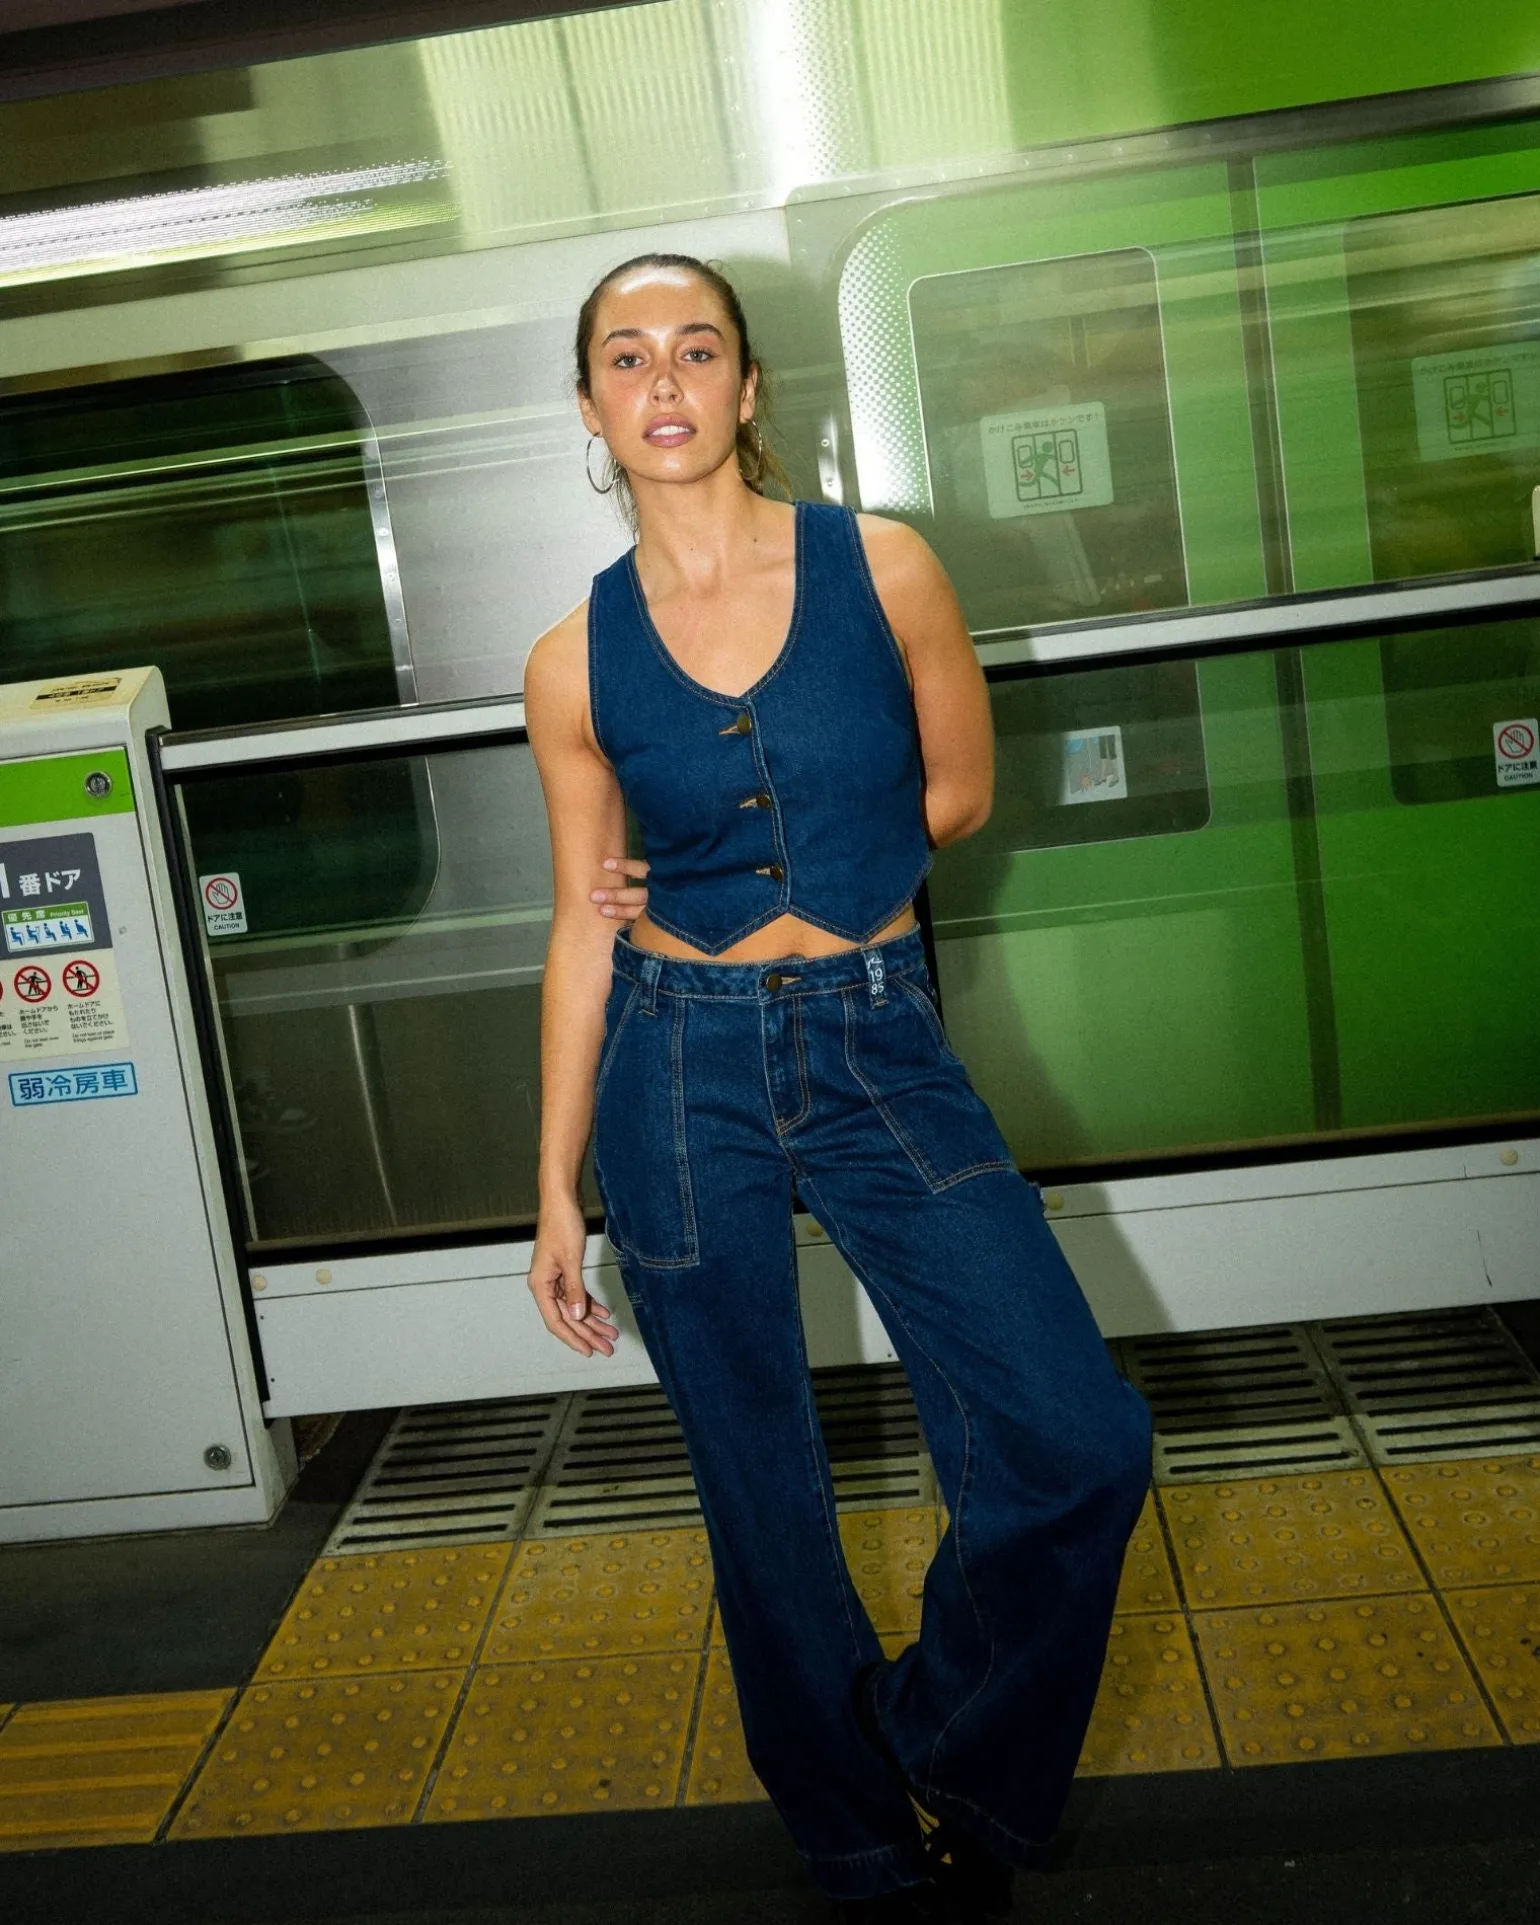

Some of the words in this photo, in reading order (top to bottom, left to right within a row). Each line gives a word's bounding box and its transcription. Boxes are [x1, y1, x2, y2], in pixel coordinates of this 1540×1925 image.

[207, 911, 243, 923] ドアに注意
[17, 1069, 128, 1100] 弱冷房車
